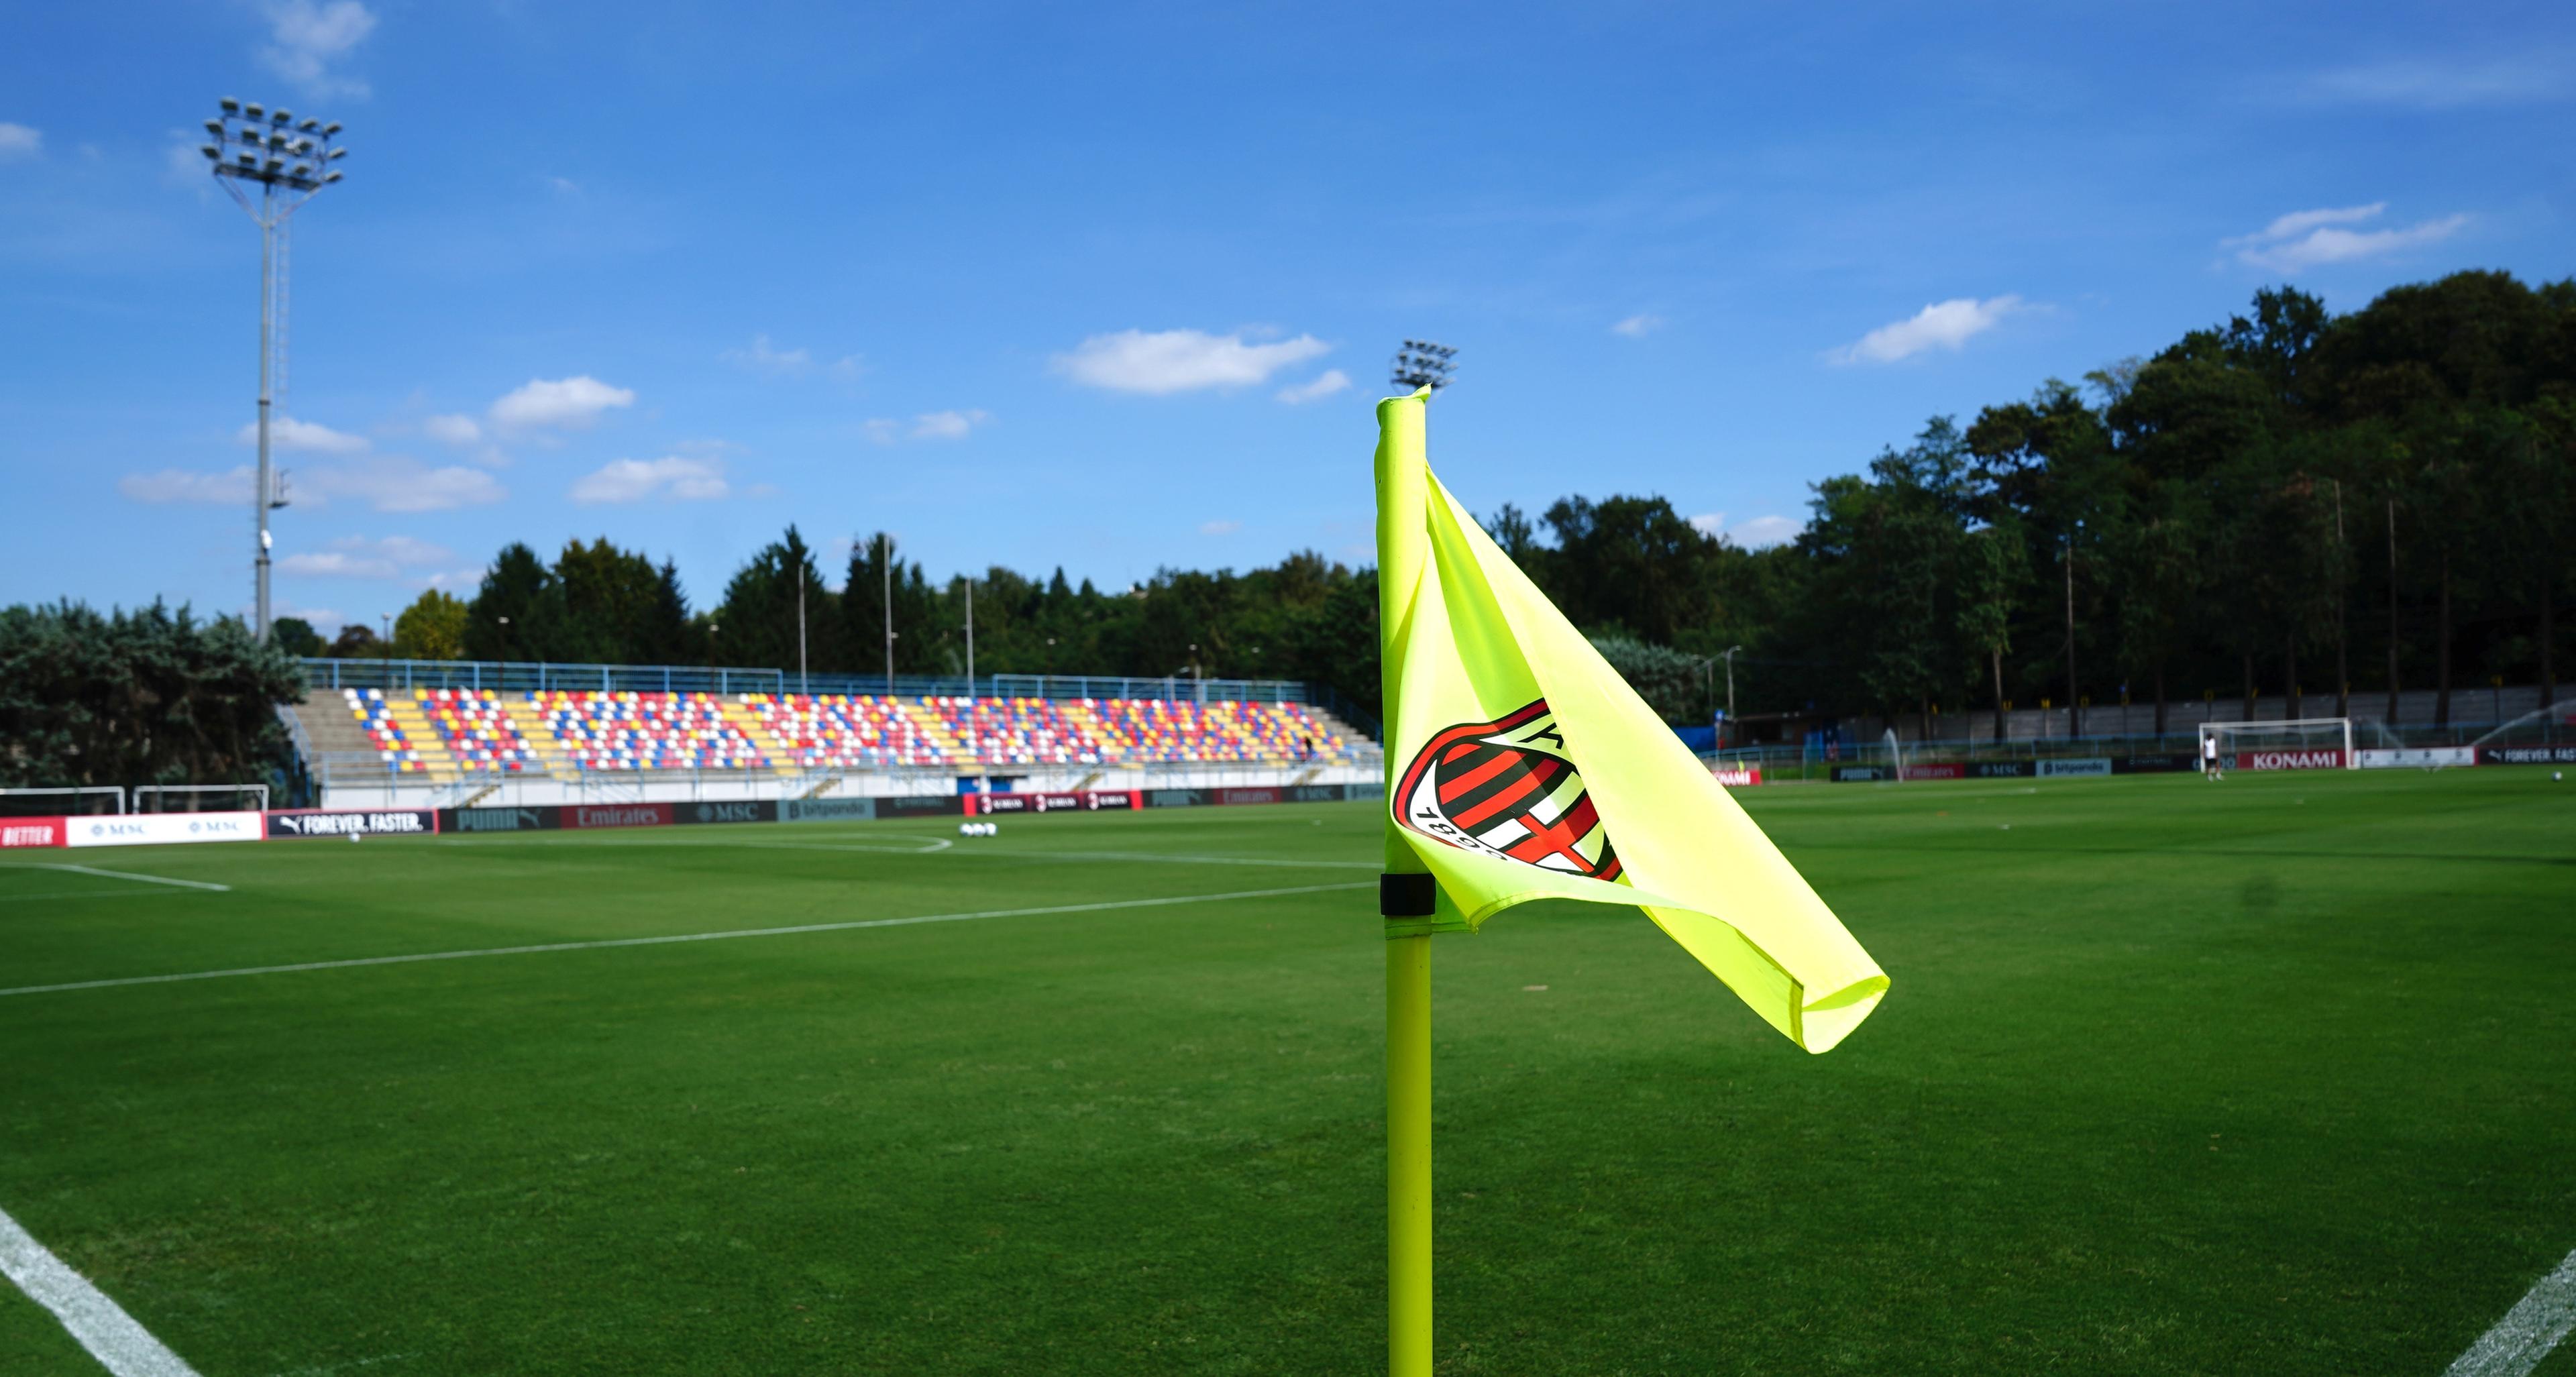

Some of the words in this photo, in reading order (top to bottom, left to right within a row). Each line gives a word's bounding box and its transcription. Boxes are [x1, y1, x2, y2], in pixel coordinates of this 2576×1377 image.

[2253, 751, 2337, 769] KONAMI
[577, 806, 659, 827] Emirates
[714, 804, 759, 822] MSC
[804, 801, 866, 817] bitpanda
[303, 814, 369, 834] FOREVER.
[370, 812, 424, 832] FASTER.
[457, 809, 520, 830] PUMA
[2, 826, 54, 846] BETTER
